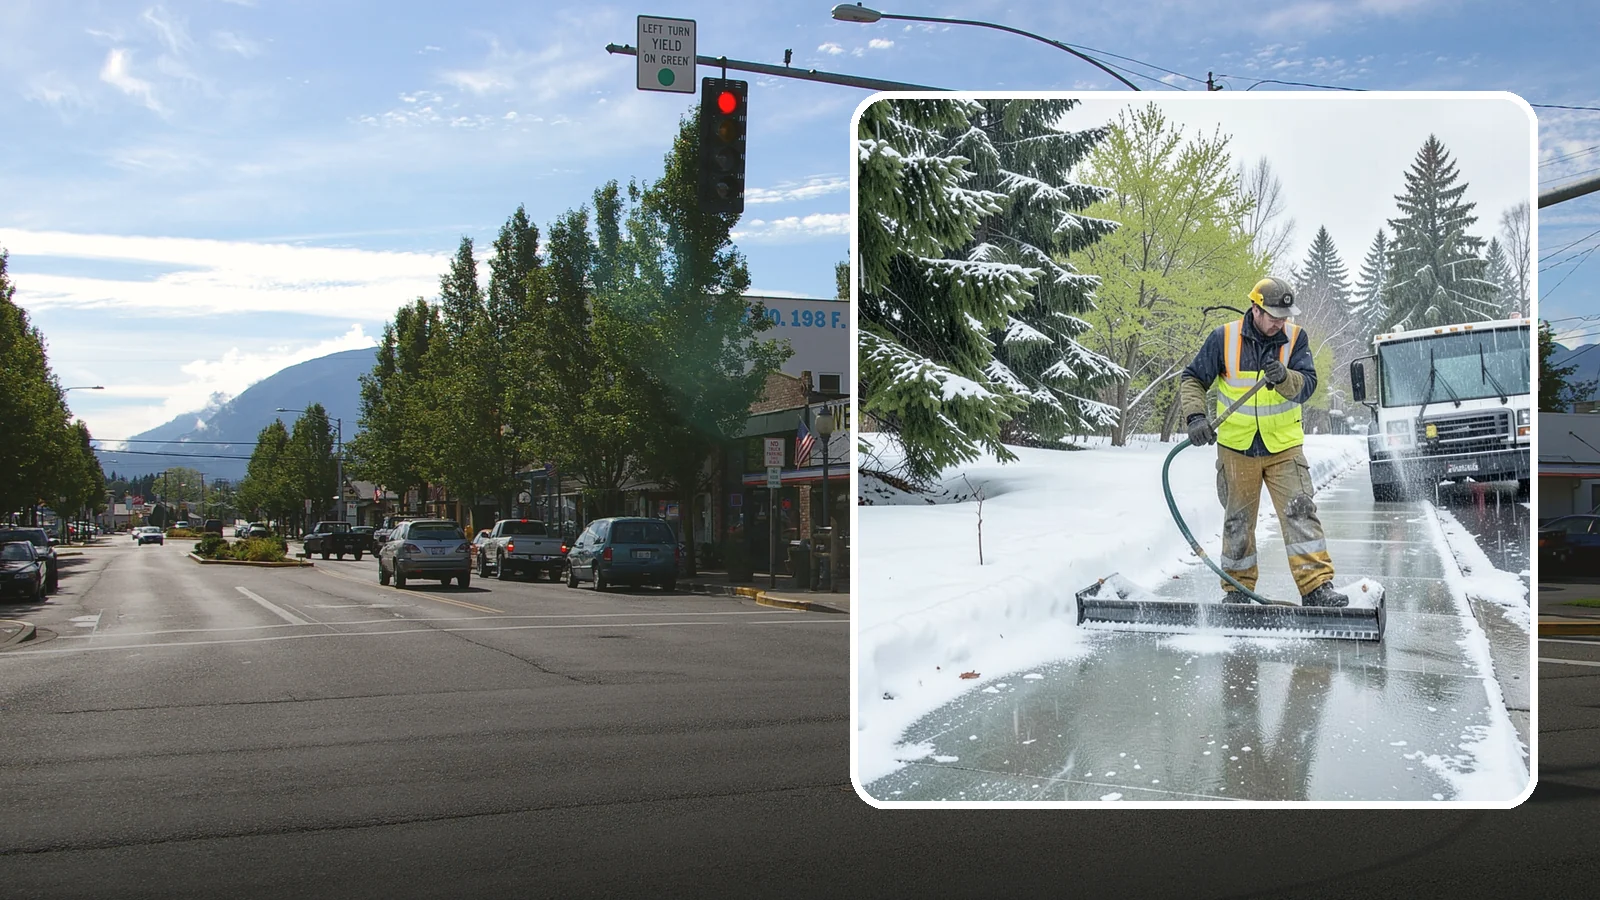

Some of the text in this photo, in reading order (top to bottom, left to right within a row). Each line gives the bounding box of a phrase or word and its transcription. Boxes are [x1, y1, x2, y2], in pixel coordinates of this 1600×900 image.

[643, 24, 690, 37] LEFT TURN
[652, 38, 682, 52] YIELD
[644, 53, 689, 66] ON GREEN
[791, 309, 826, 328] 198
[831, 311, 846, 329] F.
